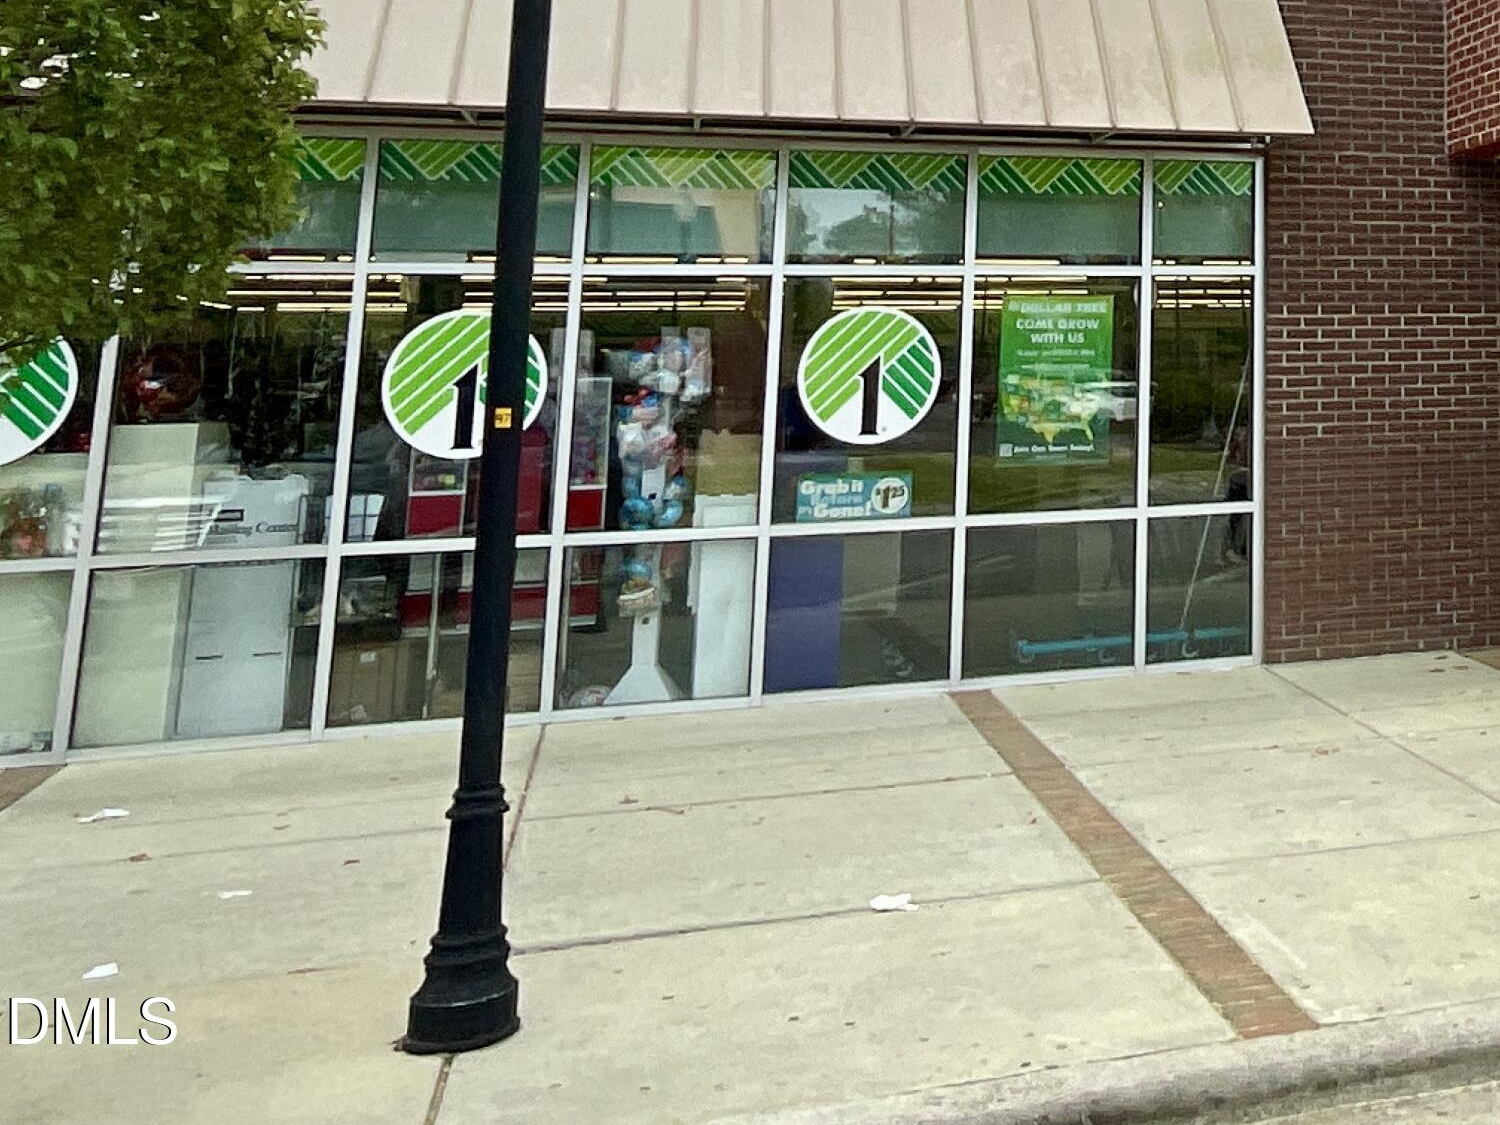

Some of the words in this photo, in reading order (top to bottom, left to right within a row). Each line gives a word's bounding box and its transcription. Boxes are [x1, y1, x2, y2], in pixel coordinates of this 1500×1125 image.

[1016, 318, 1054, 329] COME
[1057, 318, 1100, 329] GROW
[1030, 333, 1064, 343] WITH
[1067, 332, 1085, 343] US
[800, 478, 850, 496] Grab
